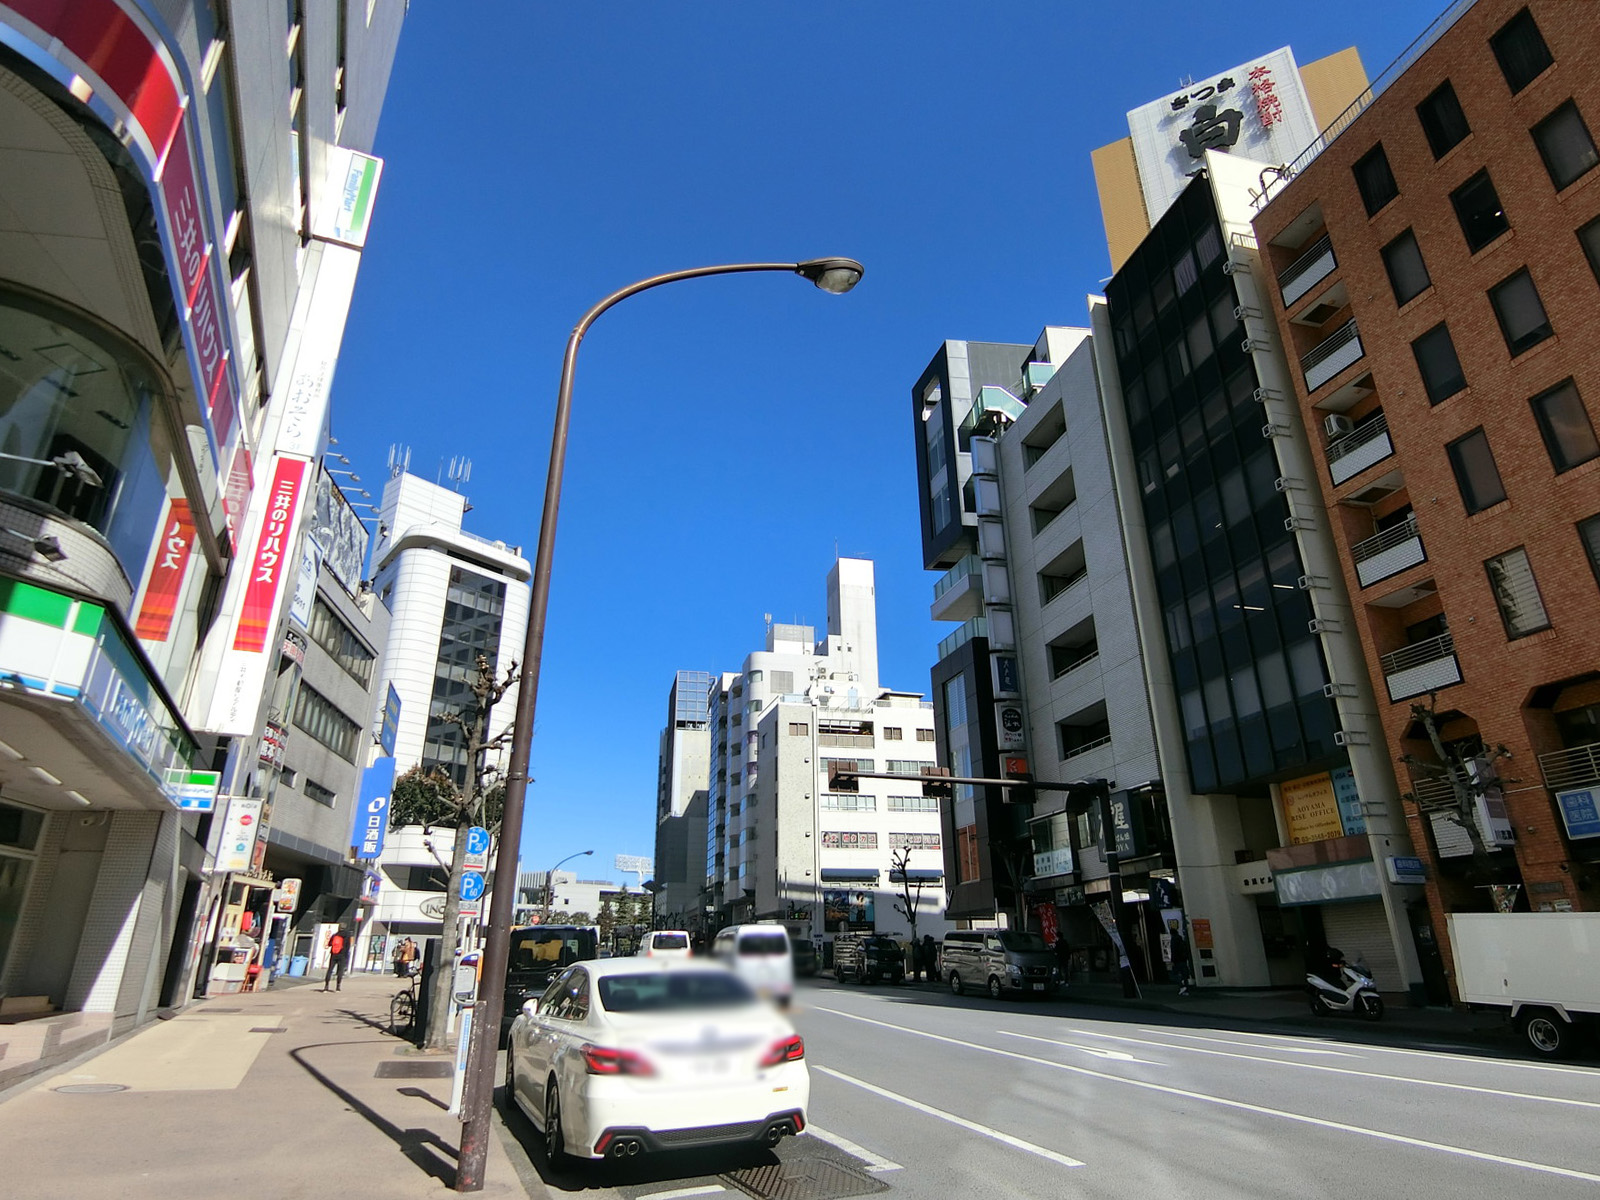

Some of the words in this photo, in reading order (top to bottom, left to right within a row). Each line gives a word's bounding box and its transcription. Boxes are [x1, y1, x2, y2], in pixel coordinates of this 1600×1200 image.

[1170, 77, 1236, 111] さつま
[1248, 65, 1283, 128] 本格焼酎
[256, 480, 295, 583] 三井のリハウス
[1309, 807, 1335, 818] OFFICE
[362, 815, 382, 853] 日酒販
[468, 832, 480, 850] P
[475, 842, 484, 851] 20
[462, 878, 475, 896] P
[469, 888, 478, 897] 60
